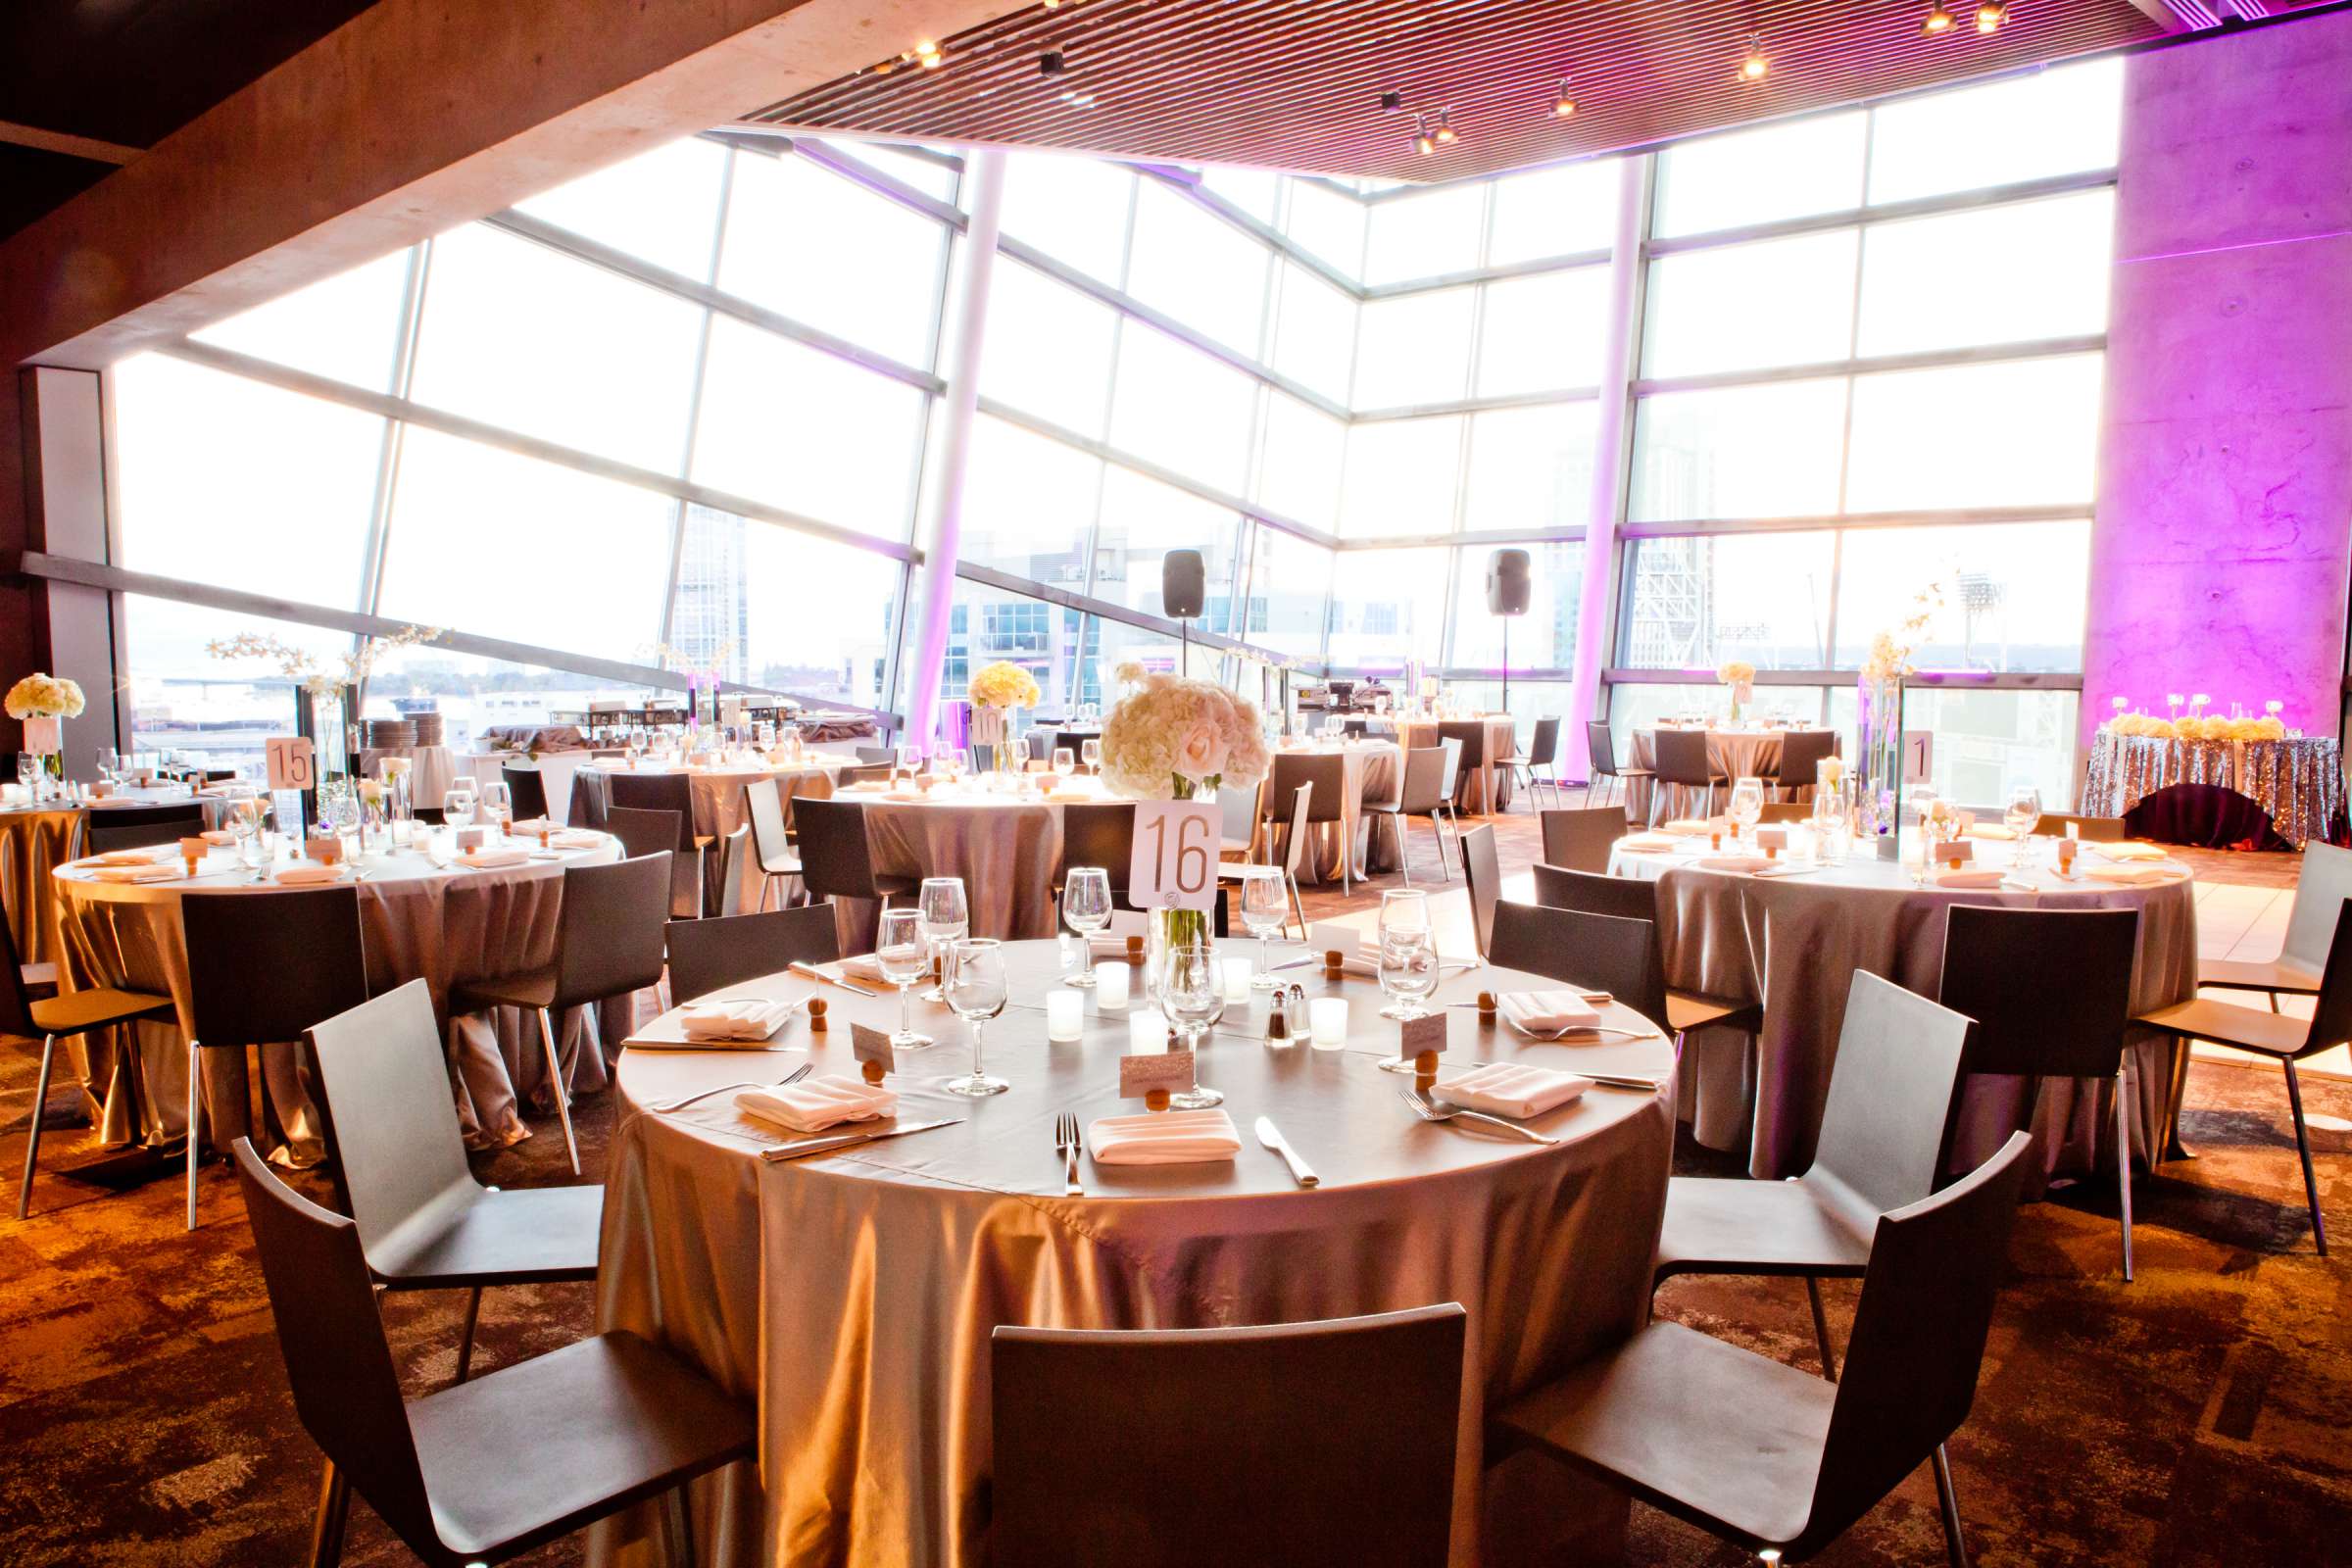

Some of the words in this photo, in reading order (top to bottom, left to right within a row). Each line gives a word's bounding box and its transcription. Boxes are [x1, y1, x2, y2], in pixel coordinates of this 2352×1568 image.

[271, 744, 307, 782] 15
[1914, 737, 1925, 777] 1
[1147, 814, 1209, 894] 16
